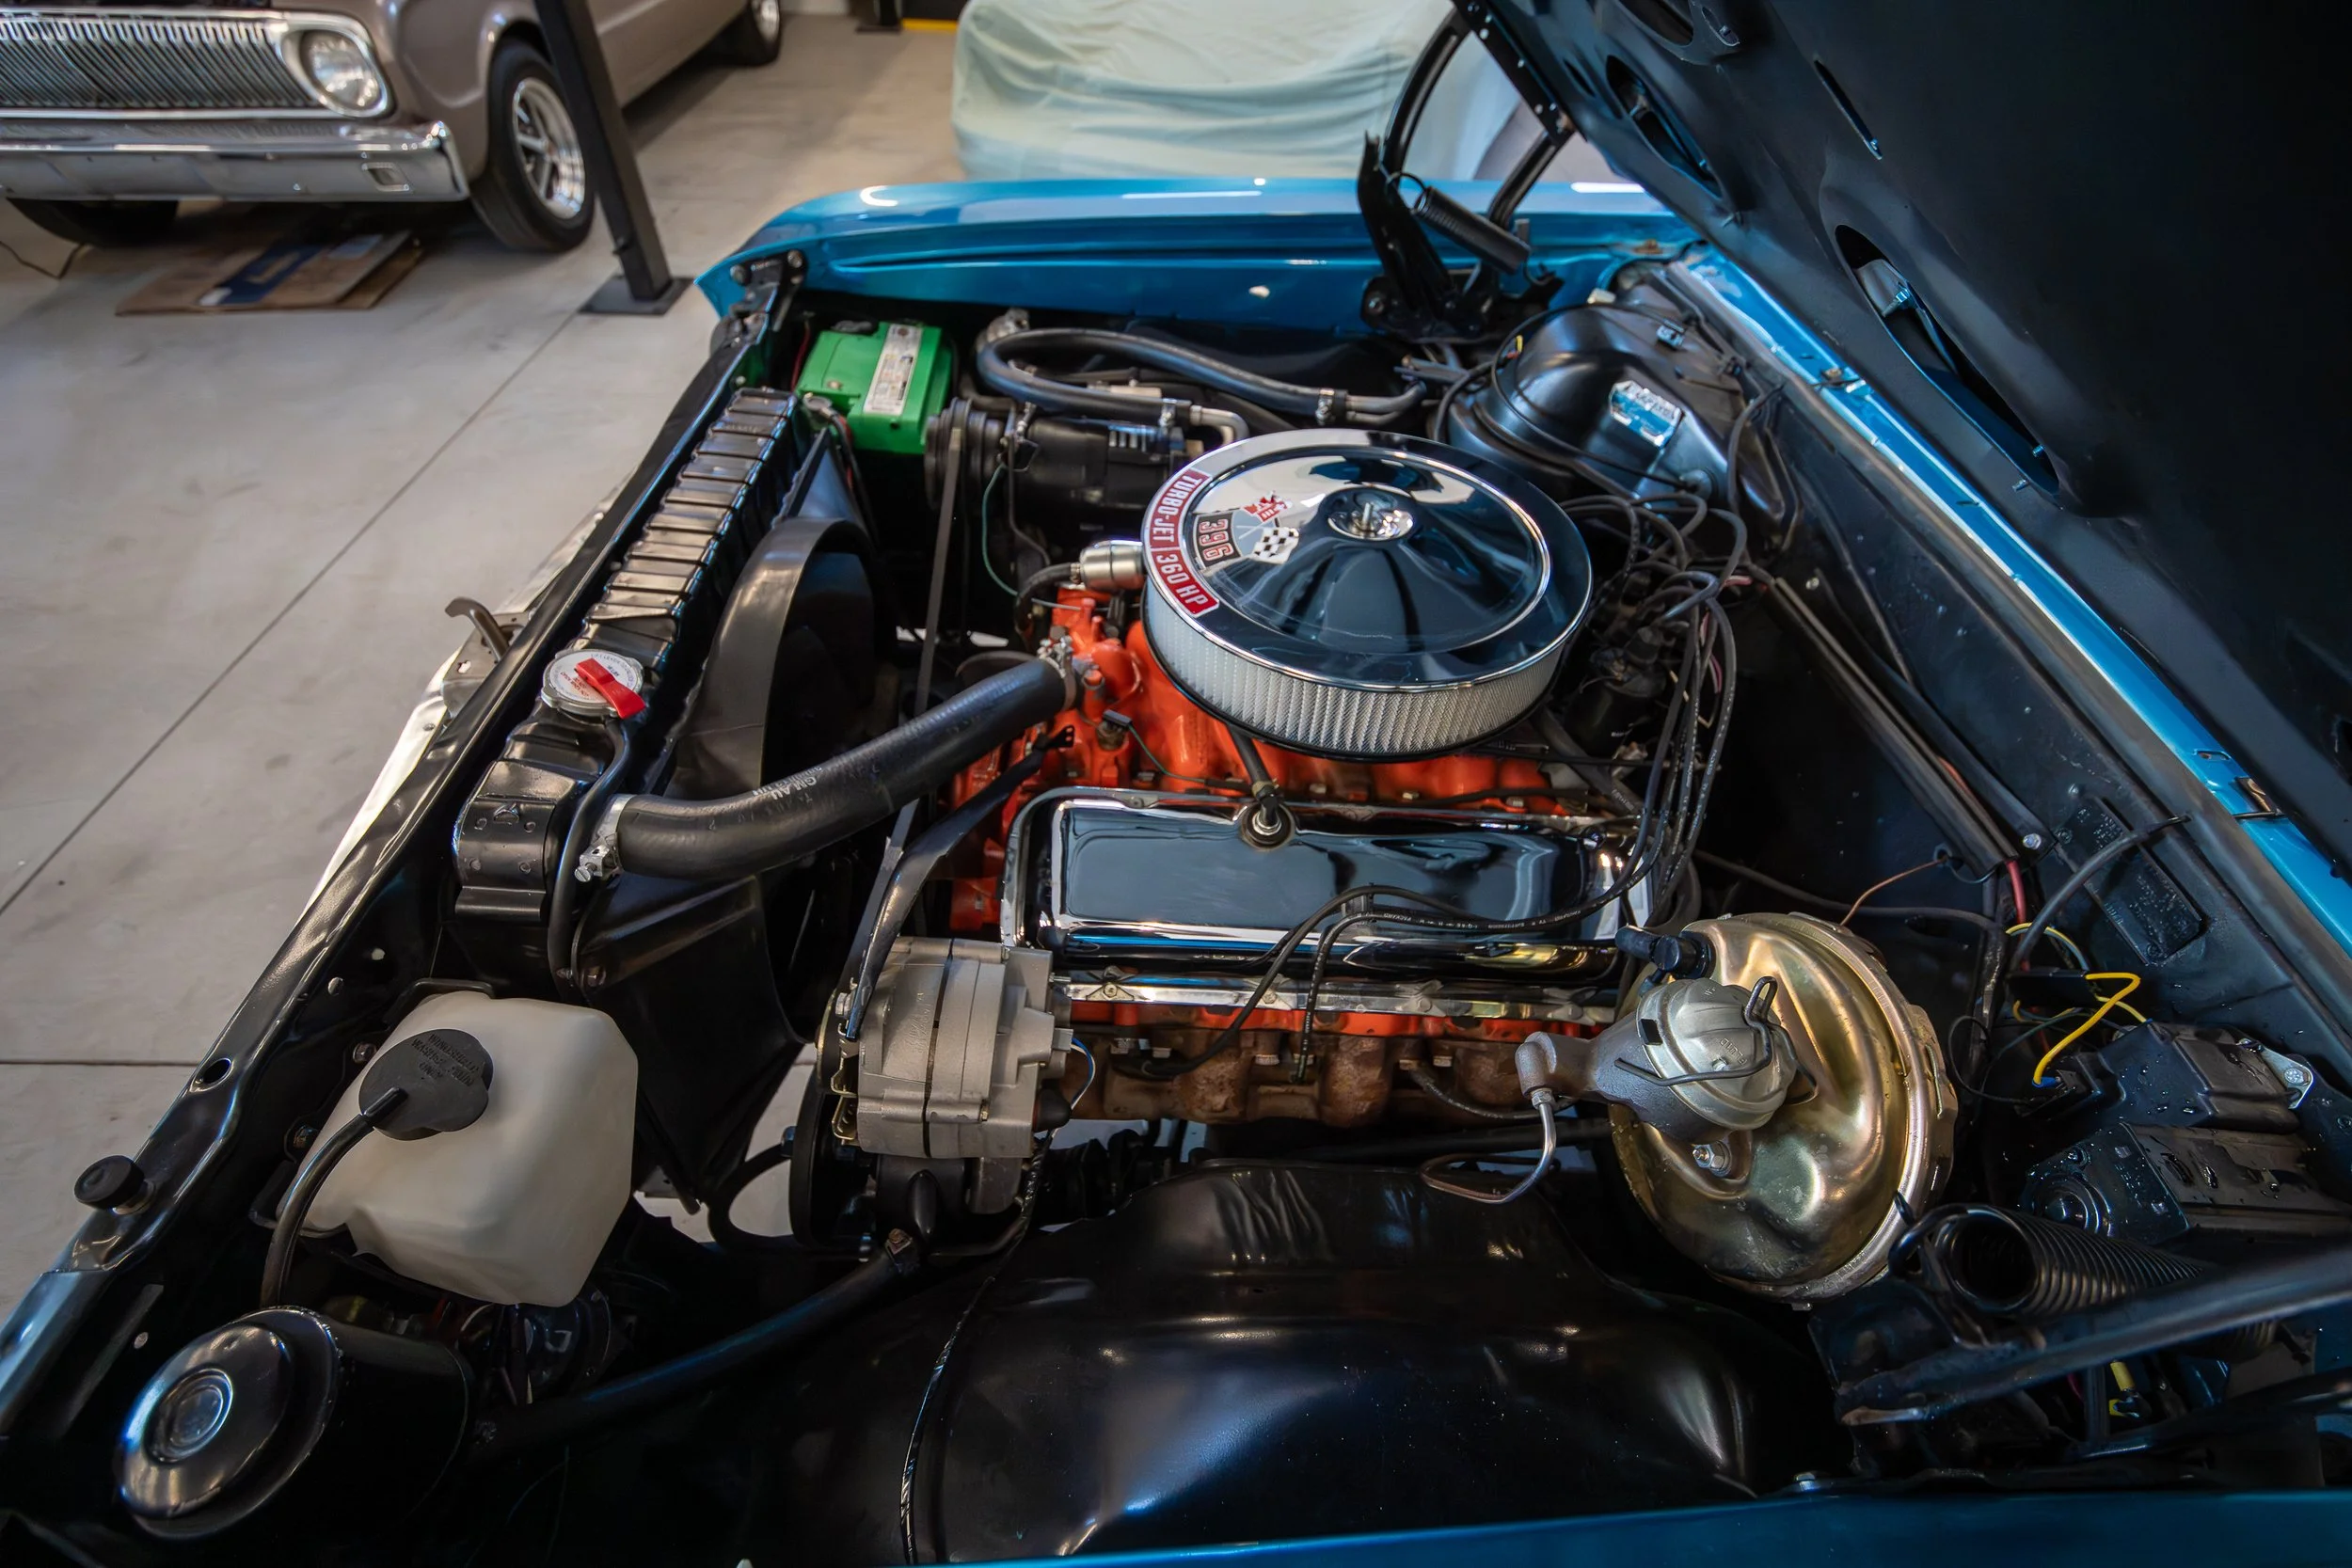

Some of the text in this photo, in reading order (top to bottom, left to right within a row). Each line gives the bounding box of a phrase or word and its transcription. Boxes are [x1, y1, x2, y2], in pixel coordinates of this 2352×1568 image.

[1152, 474, 1209, 610] TURBO-JET 360 HP
[1198, 518, 1234, 562] 396
[793, 776, 817, 791] GM
[1720, 1037, 1748, 1066] FLUID
